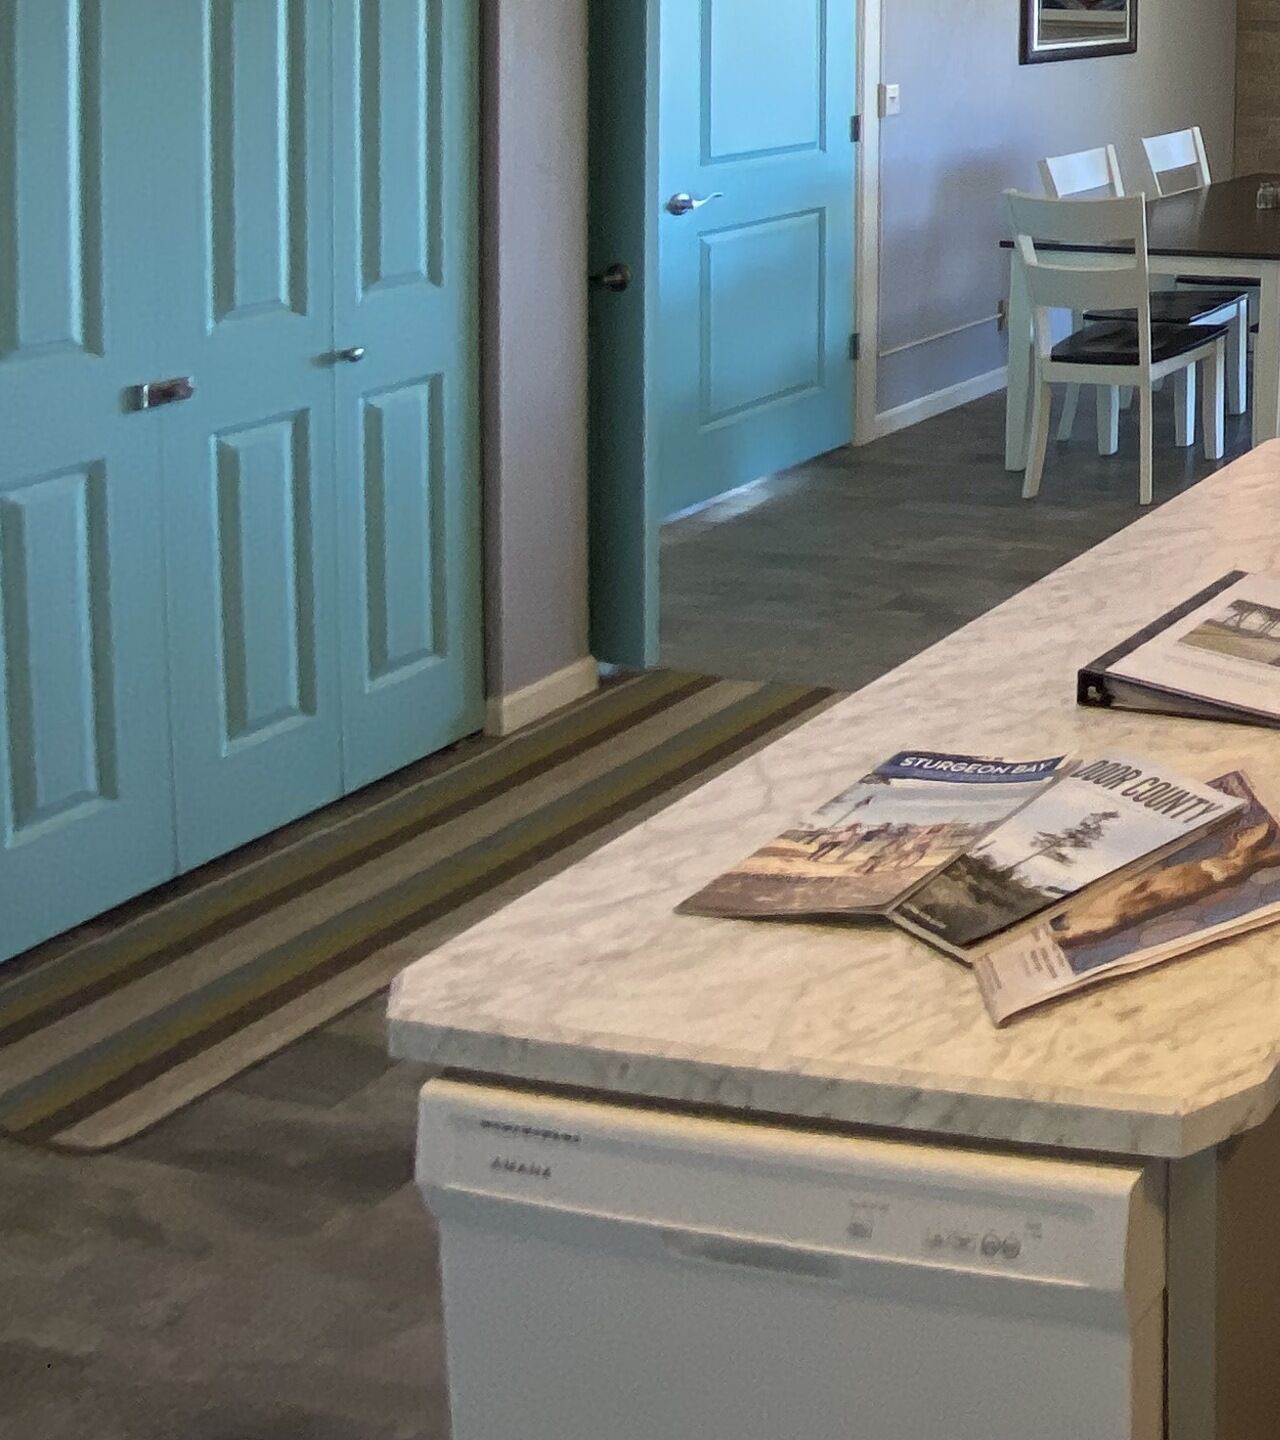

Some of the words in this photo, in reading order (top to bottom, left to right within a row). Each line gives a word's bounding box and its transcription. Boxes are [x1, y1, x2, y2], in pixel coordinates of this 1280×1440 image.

[900, 756, 1010, 775] STURGEON
[1010, 760, 1056, 775] BAY
[1069, 759, 1143, 791] DOOR
[1120, 776, 1224, 824] COUNTY
